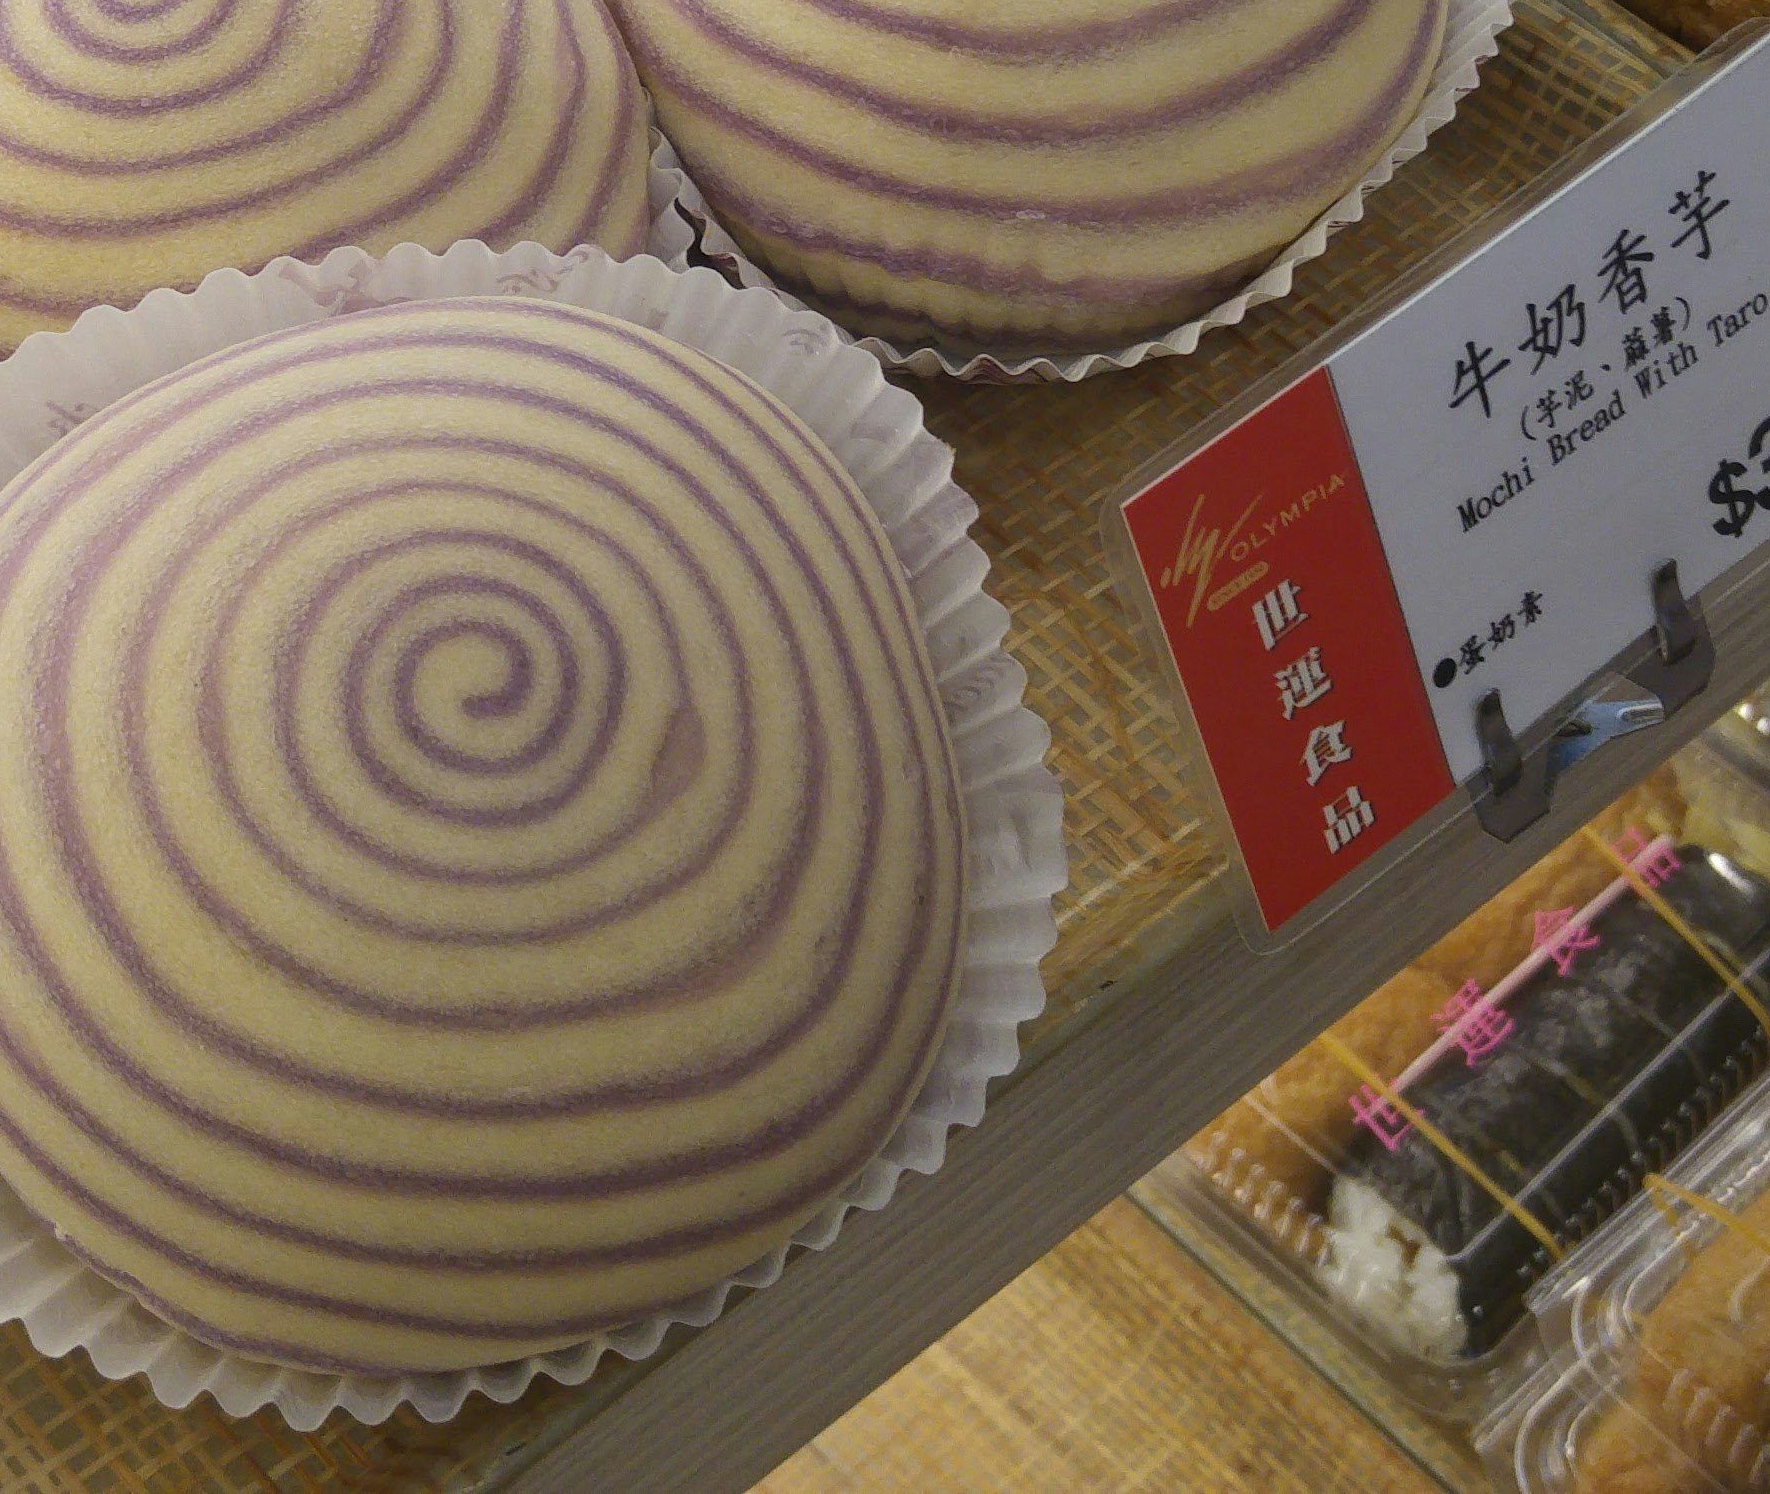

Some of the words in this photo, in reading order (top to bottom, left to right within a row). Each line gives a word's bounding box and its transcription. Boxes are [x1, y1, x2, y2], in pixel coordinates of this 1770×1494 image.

[1448, 170, 1732, 419] 牛奶香芋
[1455, 457, 1536, 533] Mochi
[1546, 389, 1627, 466] Bread
[1633, 342, 1699, 399] With
[1706, 293, 1769, 347] Taro
[1231, 473, 1346, 562] OLYMPIA
[1457, 589, 1546, 678] 蛋奶素
[1250, 578, 1377, 856] 世運食品
